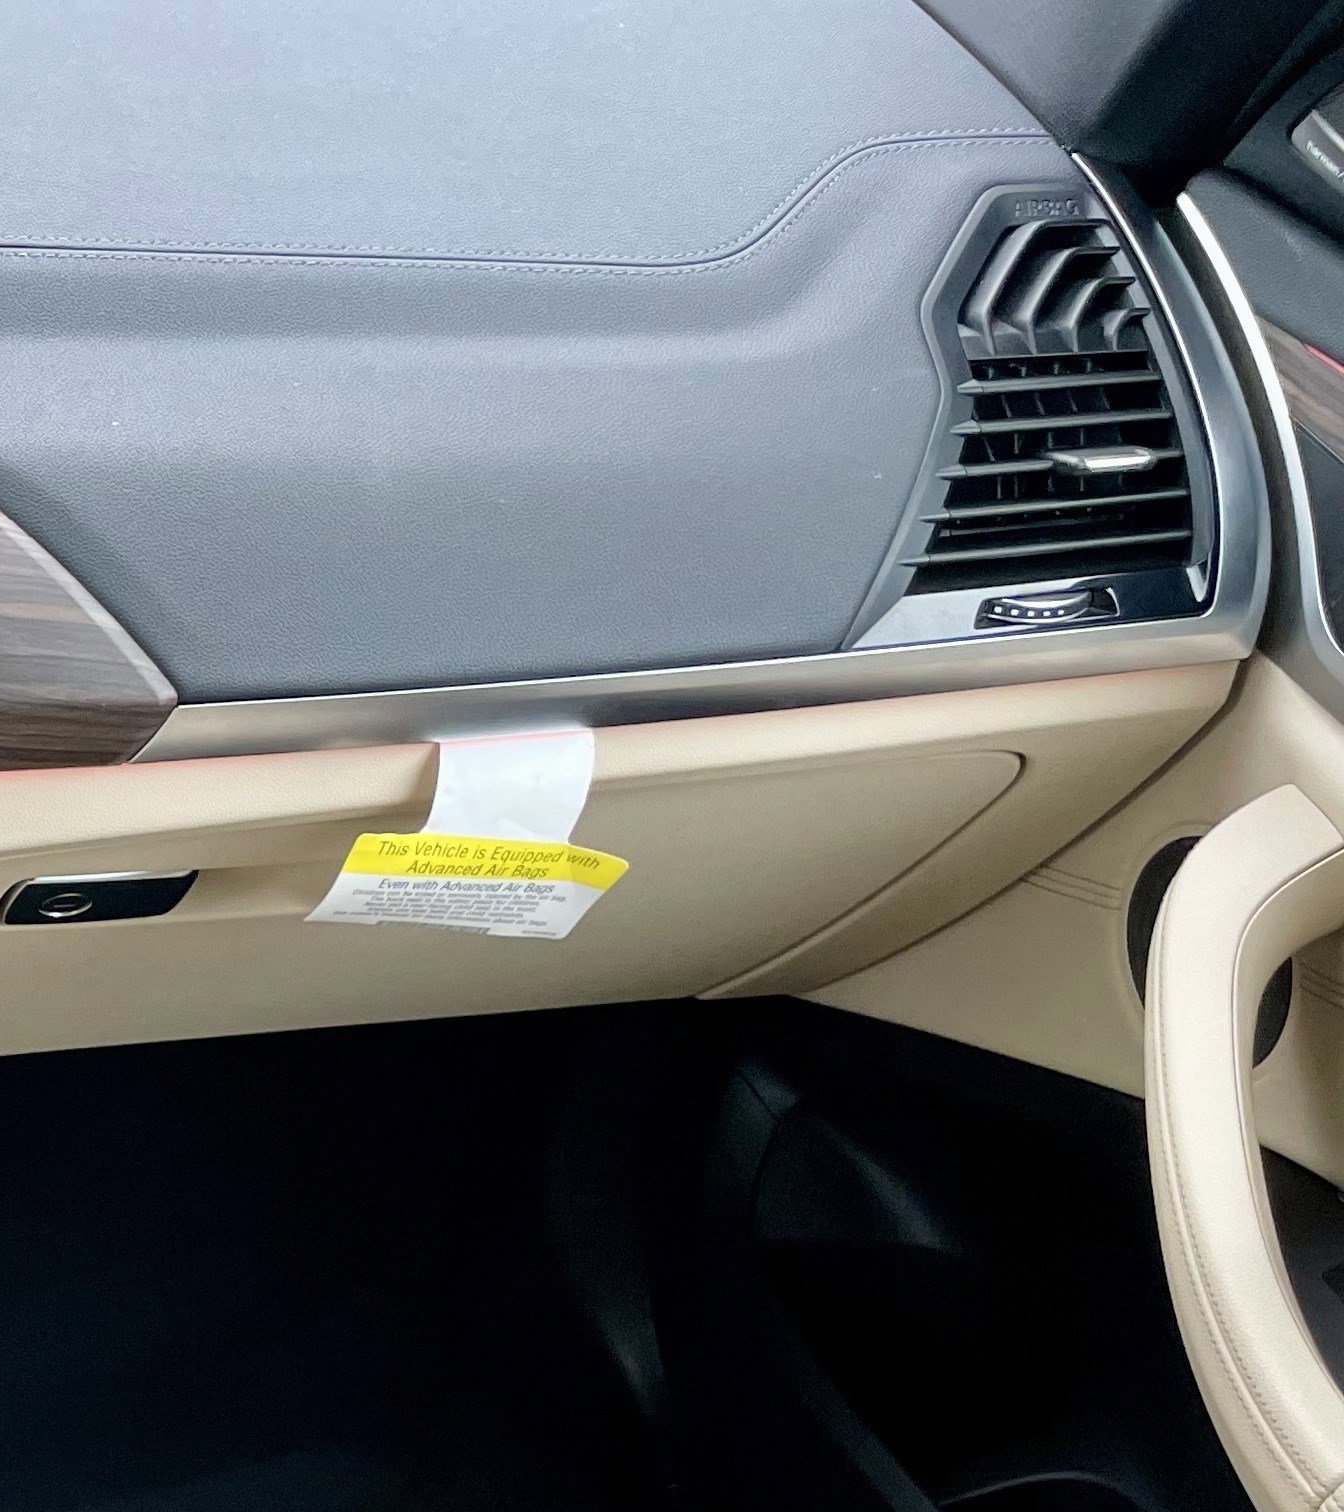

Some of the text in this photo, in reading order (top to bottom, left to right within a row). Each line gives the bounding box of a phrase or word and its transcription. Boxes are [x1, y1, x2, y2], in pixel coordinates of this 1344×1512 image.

[377, 840, 601, 870] This Vehicle is Equipped with
[405, 860, 550, 880] Advanced Air Bags
[378, 878, 410, 890] Even
[412, 880, 438, 891] with
[439, 880, 503, 893] Advanced
[501, 882, 524, 893] Air
[523, 882, 556, 895] Bags
